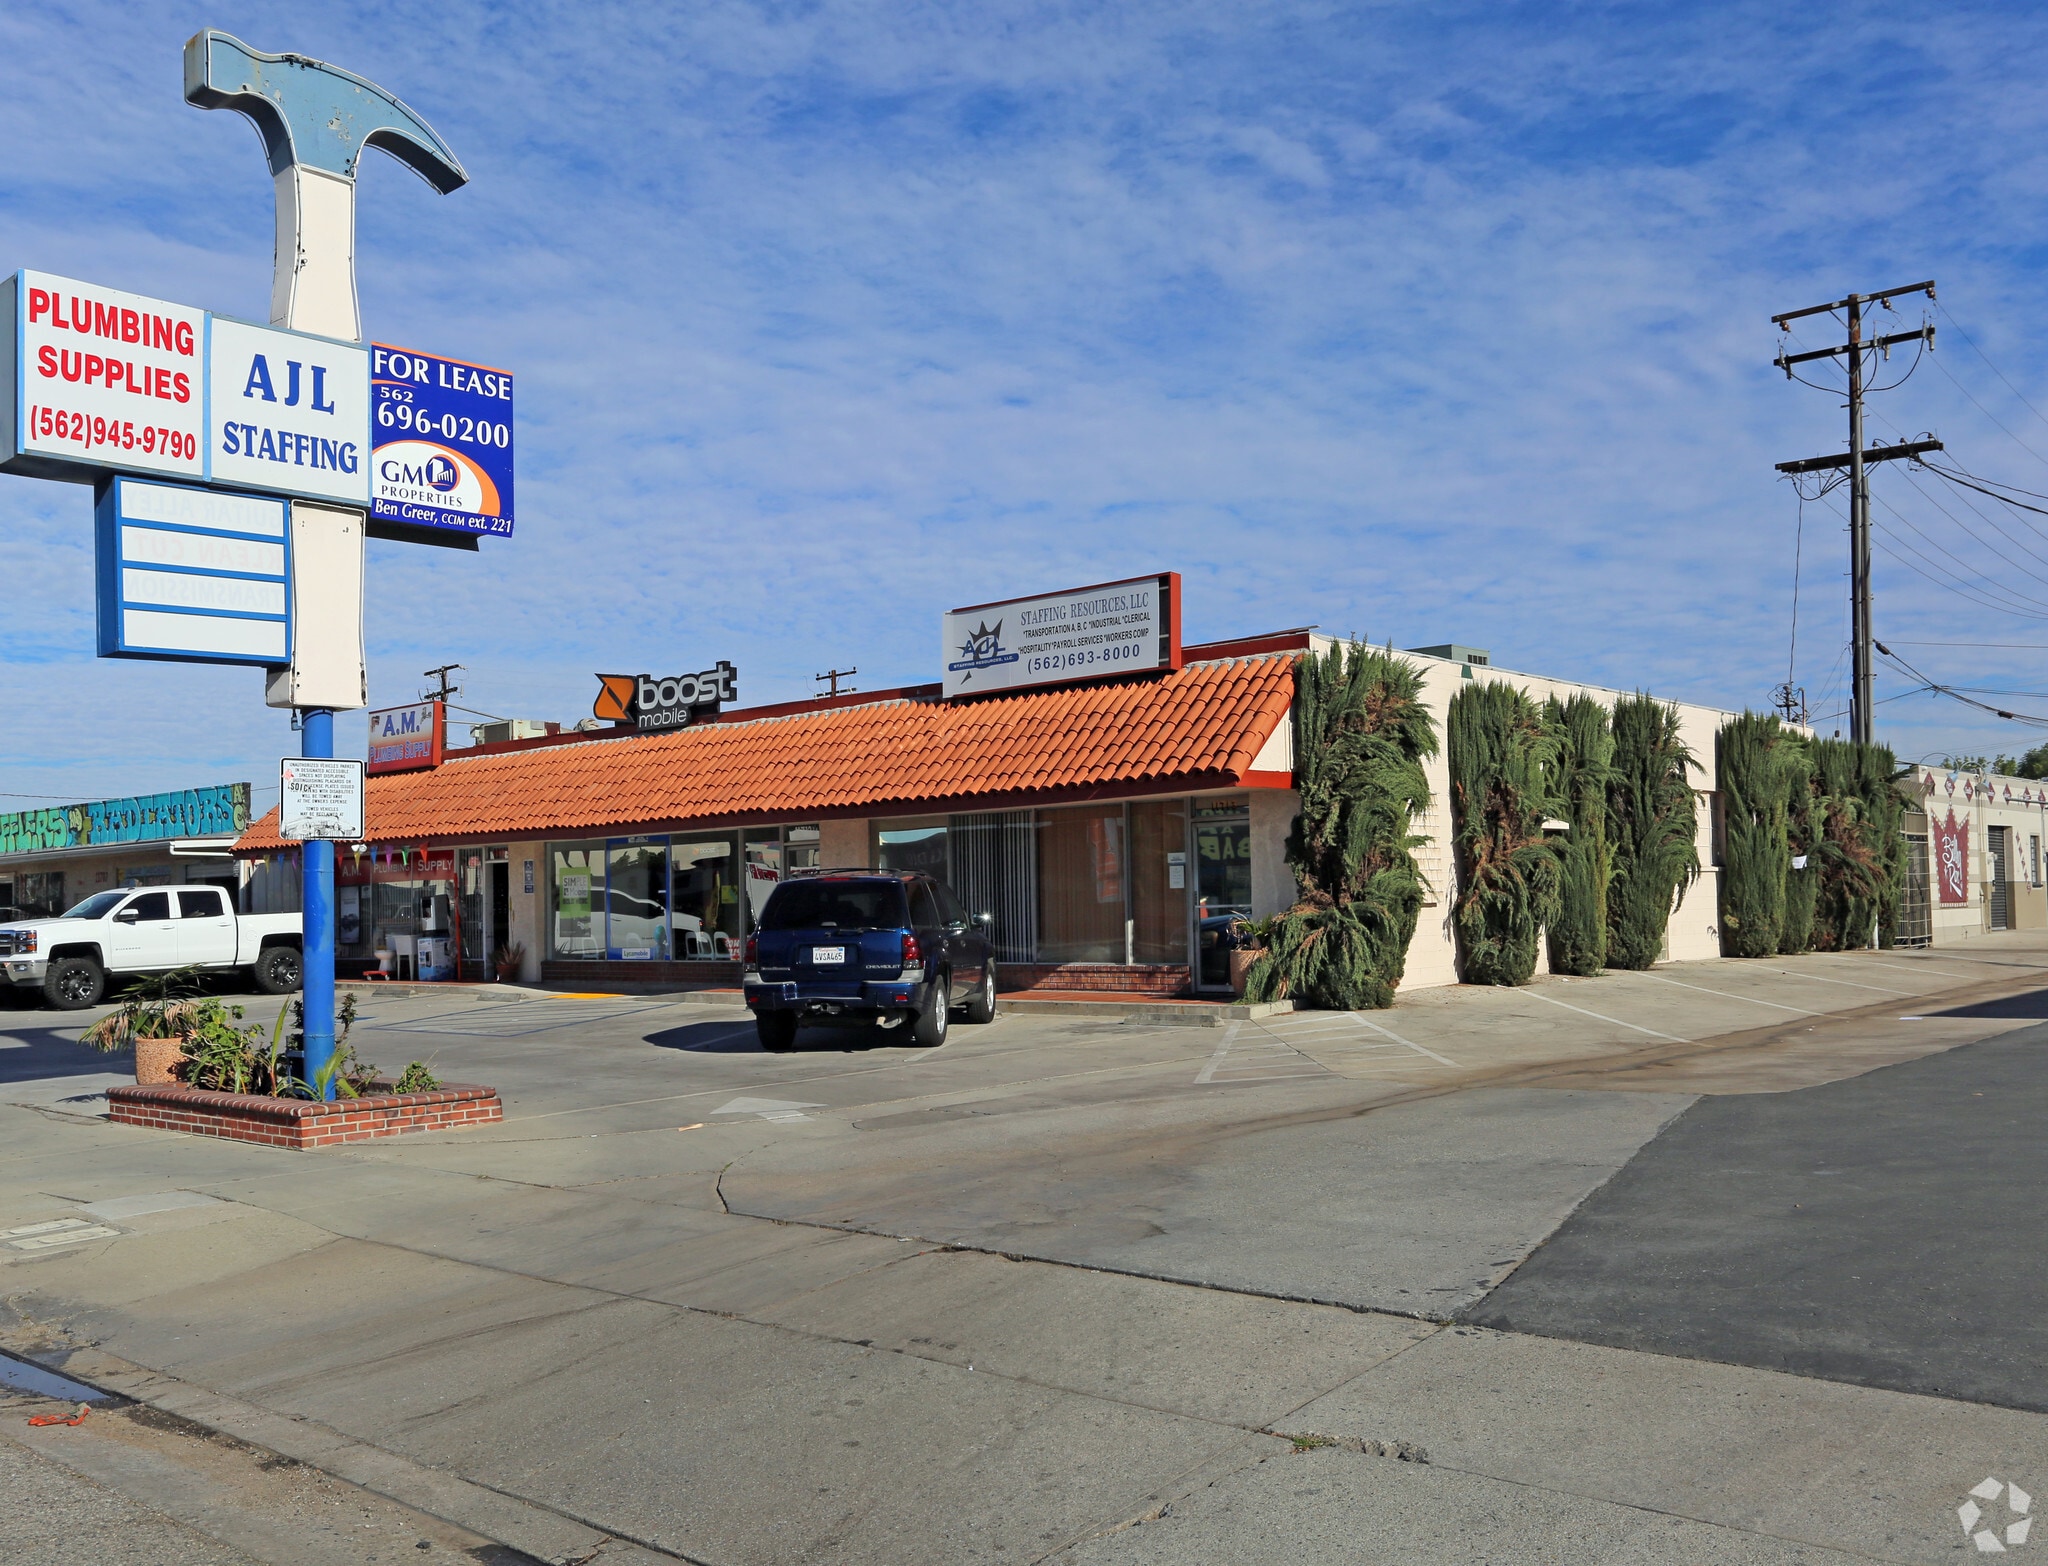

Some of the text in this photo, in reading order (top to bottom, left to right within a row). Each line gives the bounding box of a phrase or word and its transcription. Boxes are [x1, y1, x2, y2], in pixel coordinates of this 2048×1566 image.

[29, 287, 194, 356] PLUMBING
[37, 345, 191, 403] SUPPLIES
[243, 353, 335, 415] AJL
[374, 349, 511, 401] FOR LEASE
[379, 386, 414, 403] 562
[31, 405, 196, 460] (562)945-9790
[377, 401, 509, 449] 696-0200
[222, 421, 358, 474] STAFFING
[381, 484, 463, 508] PROPERTIES
[375, 498, 512, 534] Ben Greer, CCIM ext. 221
[1021, 592, 1149, 626] STAFFING RESOURCES, LLC
[962, 635, 1006, 657] AJL
[1077, 634, 1104, 646] SERVICES
[1132, 627, 1150, 639] COMP
[1027, 644, 1141, 675] (562)693-8000
[638, 665, 730, 710] boost
[382, 710, 420, 737] A.M.
[638, 708, 688, 728] mobile
[369, 739, 432, 764] PLUMBING SUPPLY
[87, 784, 233, 841] RADIATORS
[342, 860, 453, 877] A.M. PLUMBING SUPPLY
[815, 952, 842, 962] 4VSA465
